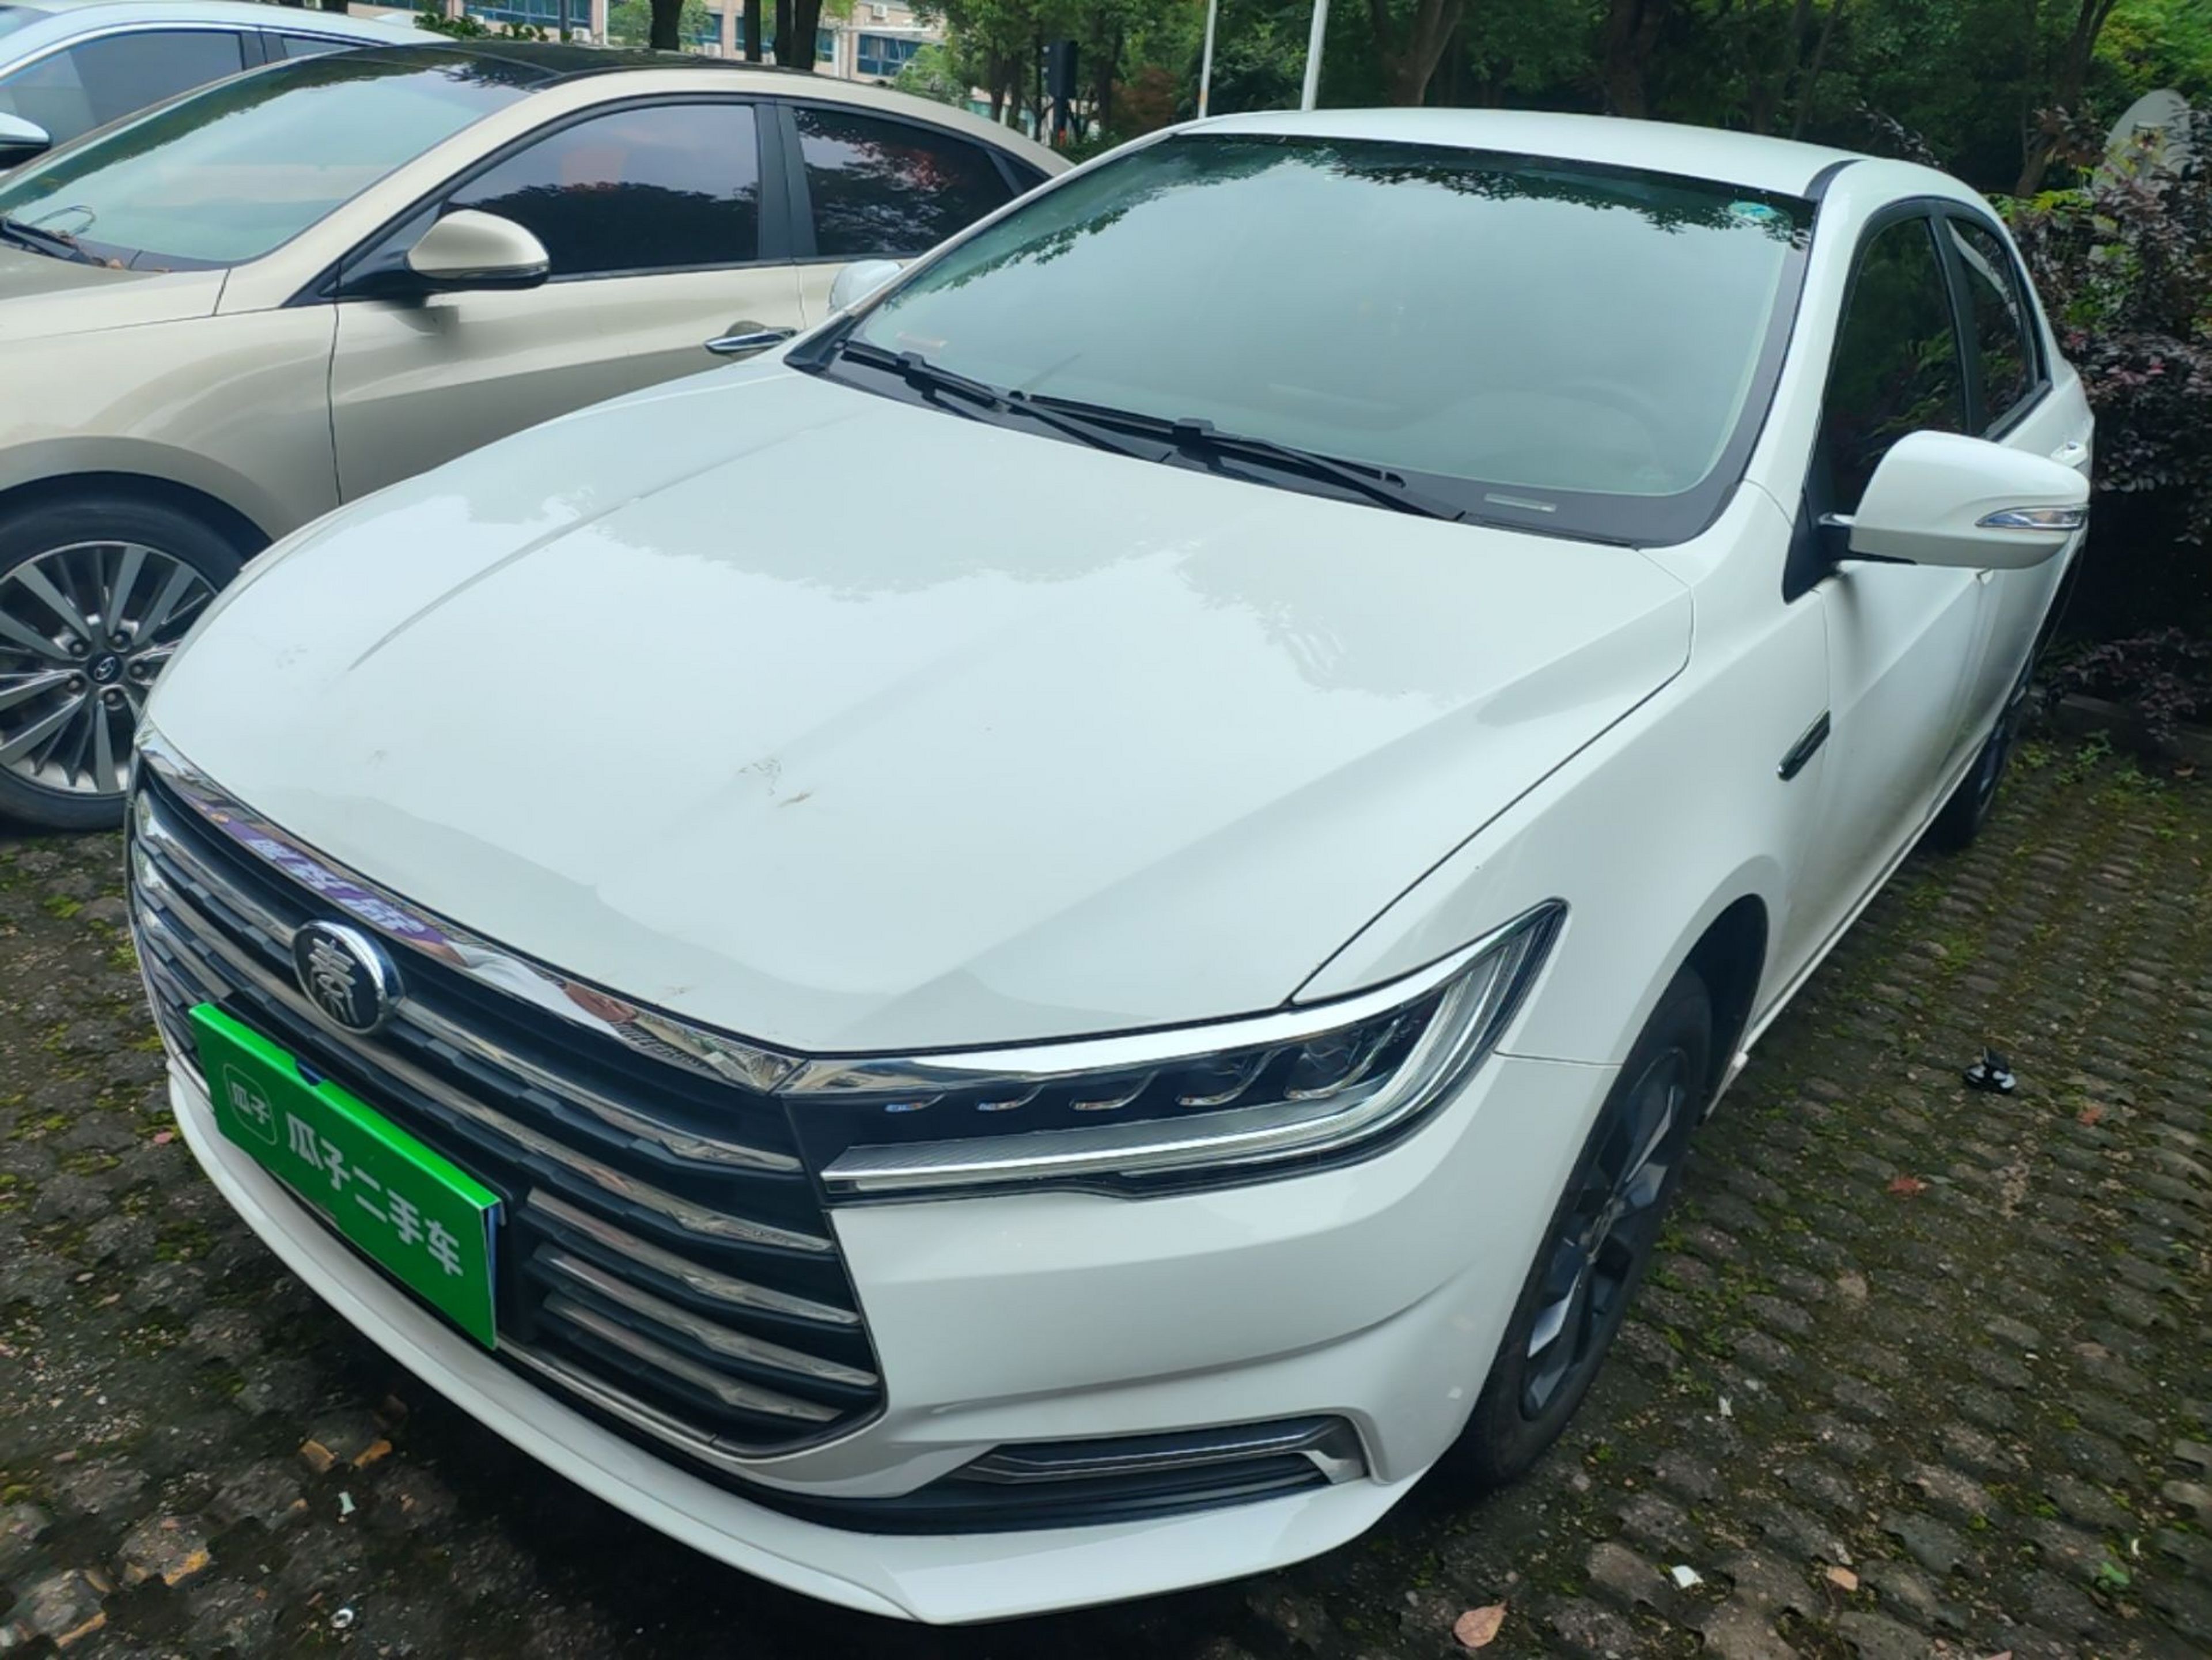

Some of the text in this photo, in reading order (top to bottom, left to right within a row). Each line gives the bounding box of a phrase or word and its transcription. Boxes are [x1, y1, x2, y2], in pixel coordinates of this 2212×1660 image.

[230, 1082, 272, 1126] 瓜子
[285, 1111, 464, 1277] 瓜子二手车
